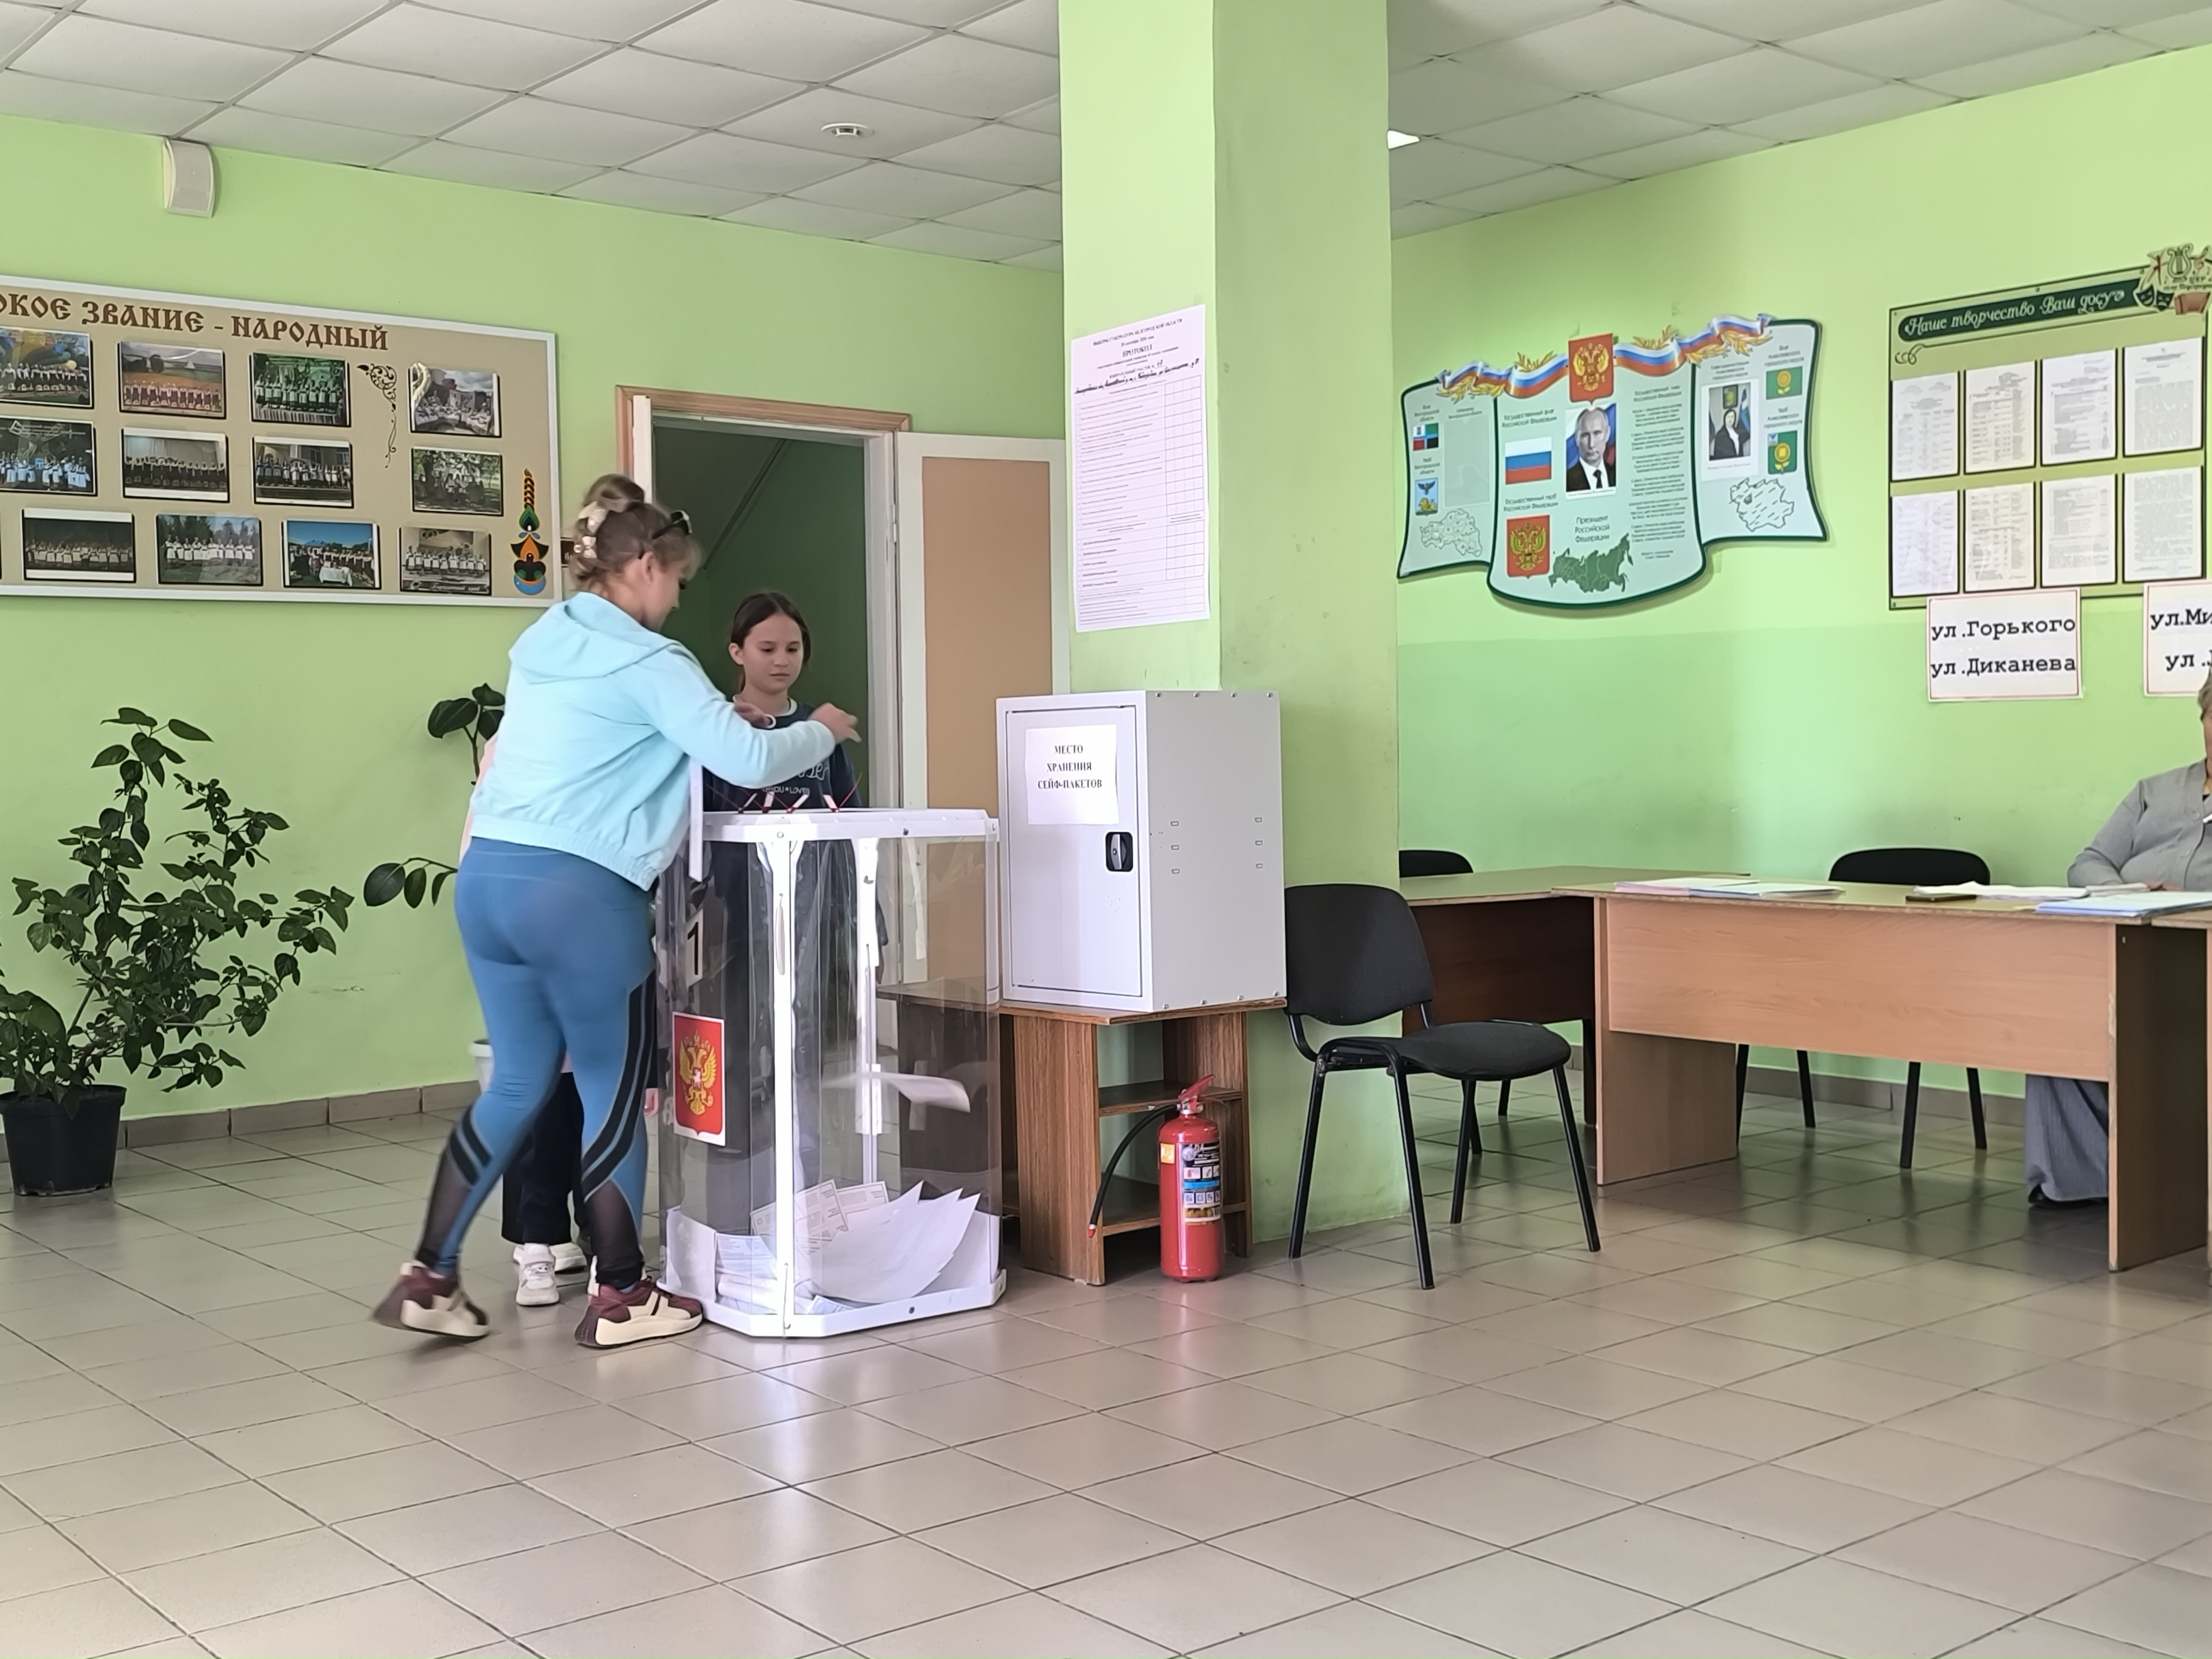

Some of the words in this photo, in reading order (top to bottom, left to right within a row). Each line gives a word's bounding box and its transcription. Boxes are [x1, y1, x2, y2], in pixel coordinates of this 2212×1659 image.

[1904, 316, 1947, 336] Наше
[1951, 304, 2035, 329] творчество
[2039, 297, 2075, 314] Ваш
[82, 301, 204, 332] ЗВАНИЕ
[231, 316, 388, 350] НАРОДНЫЙ
[1054, 745, 1083, 755] МЕСТО
[1047, 762, 1091, 772] ХРАНЕНИЯ
[1038, 779, 1102, 789] СЕЙФ-ПАКЕТОВ
